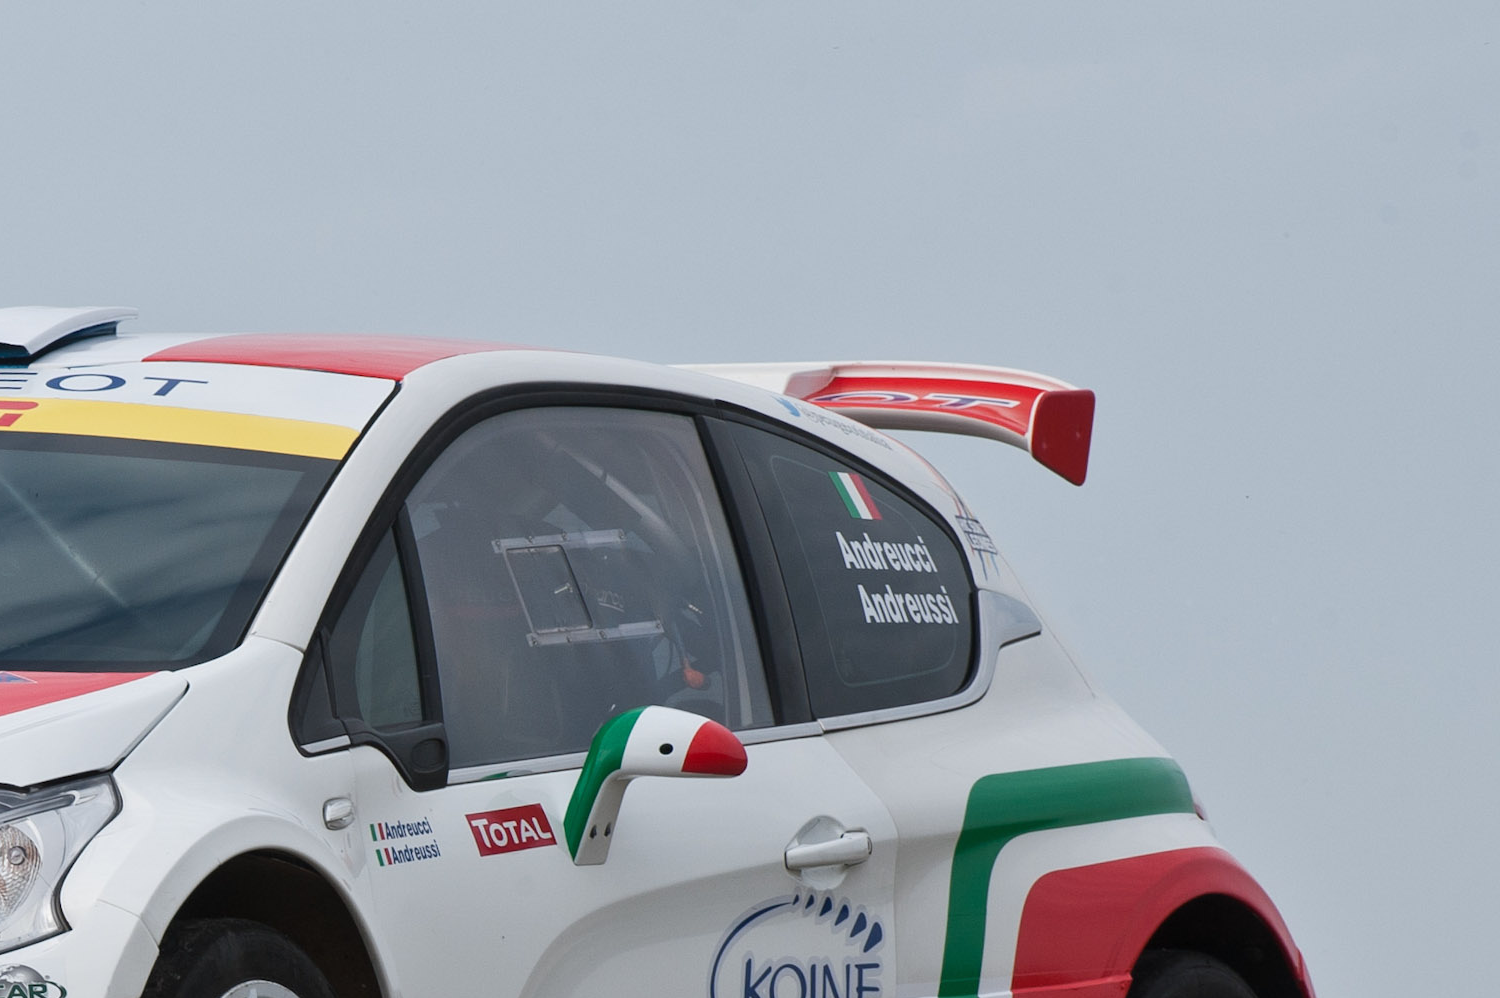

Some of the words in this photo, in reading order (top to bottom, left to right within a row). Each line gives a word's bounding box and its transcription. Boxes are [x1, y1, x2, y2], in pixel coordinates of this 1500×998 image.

[835, 531, 938, 573] Andreucci
[857, 584, 960, 625] Andreussi
[384, 816, 433, 841] Andreucci
[471, 817, 553, 849] TOTAL
[390, 840, 441, 865] Andreussi
